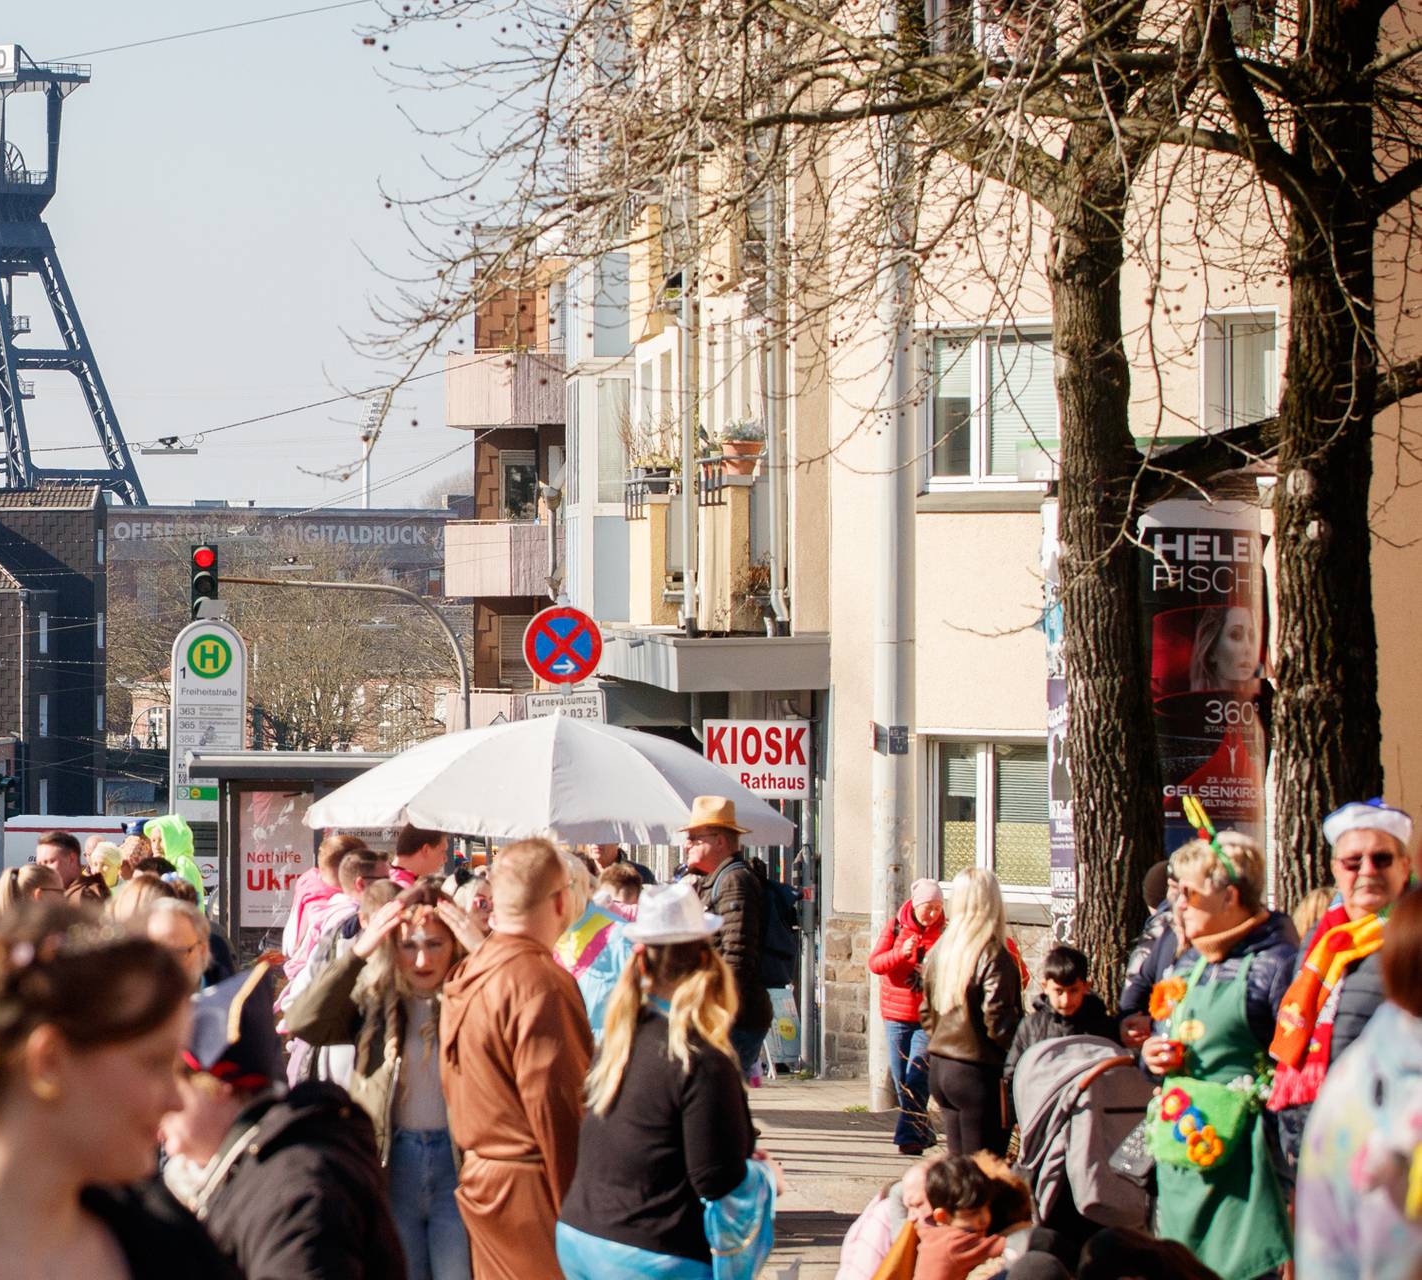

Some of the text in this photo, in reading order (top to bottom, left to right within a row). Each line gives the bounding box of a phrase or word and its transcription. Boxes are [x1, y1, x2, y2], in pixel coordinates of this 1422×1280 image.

[284, 525, 426, 545] DIGITALDRUCK
[200, 645, 219, 669] H
[180, 667, 186, 679] 1
[181, 686, 237, 697] Freiheitstraße
[531, 695, 597, 707] Karnevalsumzug
[179, 720, 195, 730] 365
[707, 726, 806, 766] KIOSK
[741, 772, 805, 791] Rathaus
[246, 850, 302, 863] Nothilfe
[246, 868, 302, 892] Ukr
